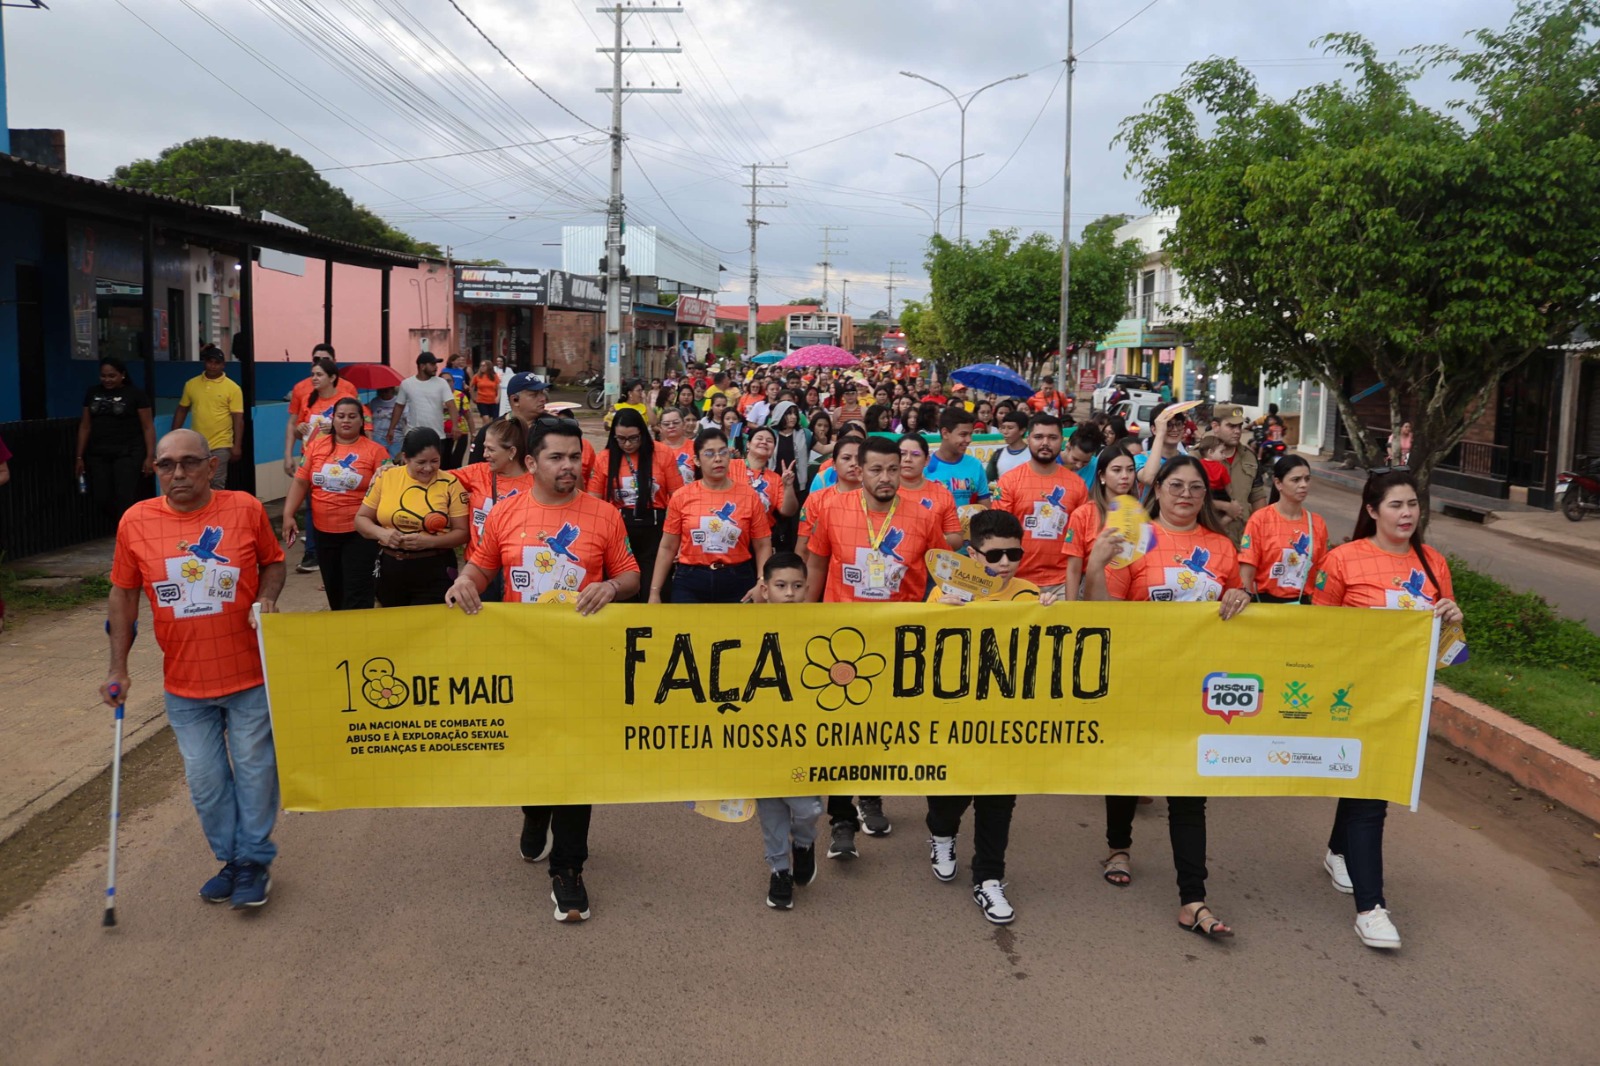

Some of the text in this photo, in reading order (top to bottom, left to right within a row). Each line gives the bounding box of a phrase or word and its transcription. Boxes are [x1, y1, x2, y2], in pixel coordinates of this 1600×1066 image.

[625, 625, 1110, 715] FAÇA BONITO
[336, 657, 514, 713] 18 DE MAIO
[1213, 684, 1255, 693] DISQUE
[1210, 691, 1253, 707] 100
[348, 718, 505, 732] DIA NACIONAL DE COMBATE AO
[346, 730, 510, 743] ABUSO E À EXPLORAÇÃO SEXUAL
[624, 720, 1104, 752] PROTEJA NOSSAS CRIANÇAS E ADOLESCENTES.
[350, 742, 505, 755] DE CRIANÇAS E ADOLESCENTES
[1221, 754, 1252, 764] eneva
[809, 764, 947, 782] FACABONITO.ORG
